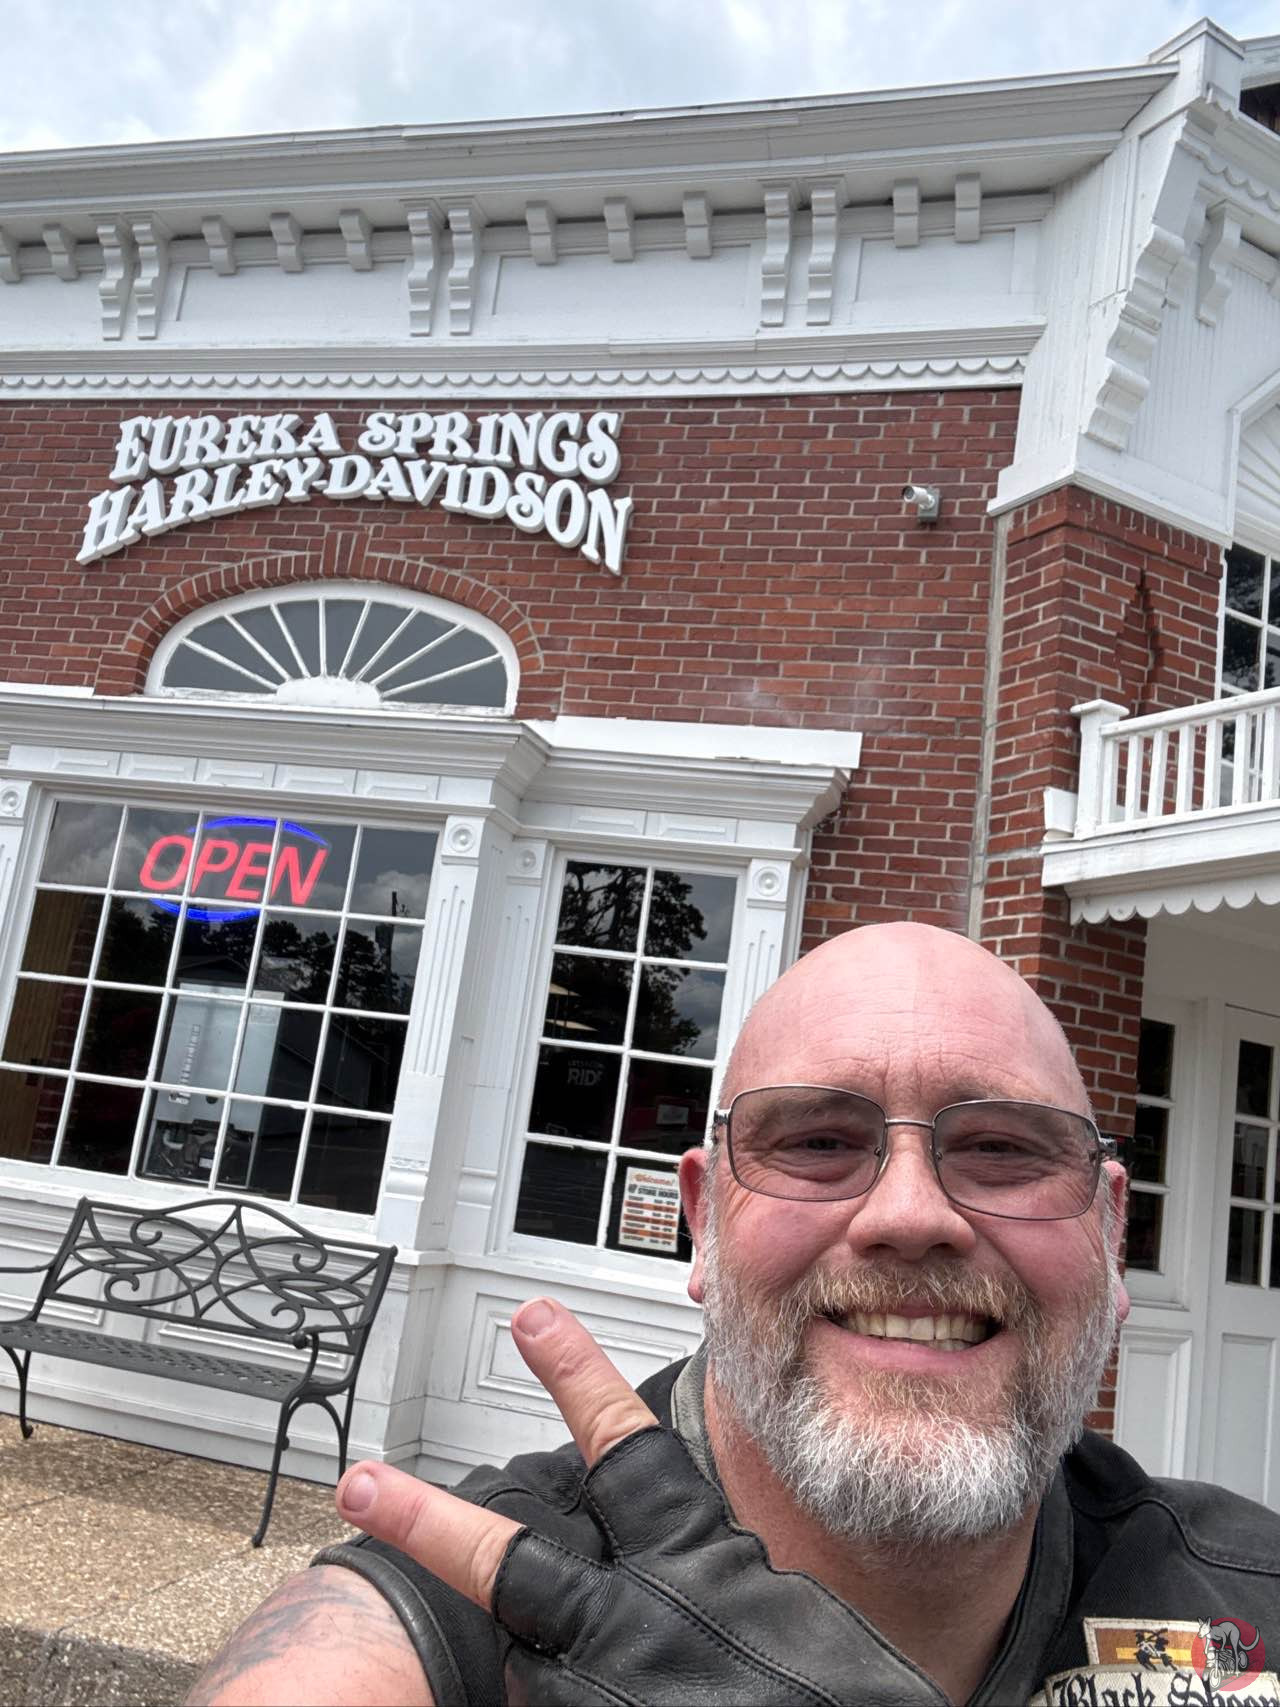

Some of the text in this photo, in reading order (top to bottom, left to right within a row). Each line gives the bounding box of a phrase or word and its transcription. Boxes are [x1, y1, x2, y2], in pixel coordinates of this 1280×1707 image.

[109, 411, 622, 484] EUREKA SPRINGS
[75, 454, 634, 576] HARLEY-DAVIDSON
[139, 834, 329, 905] OPEN
